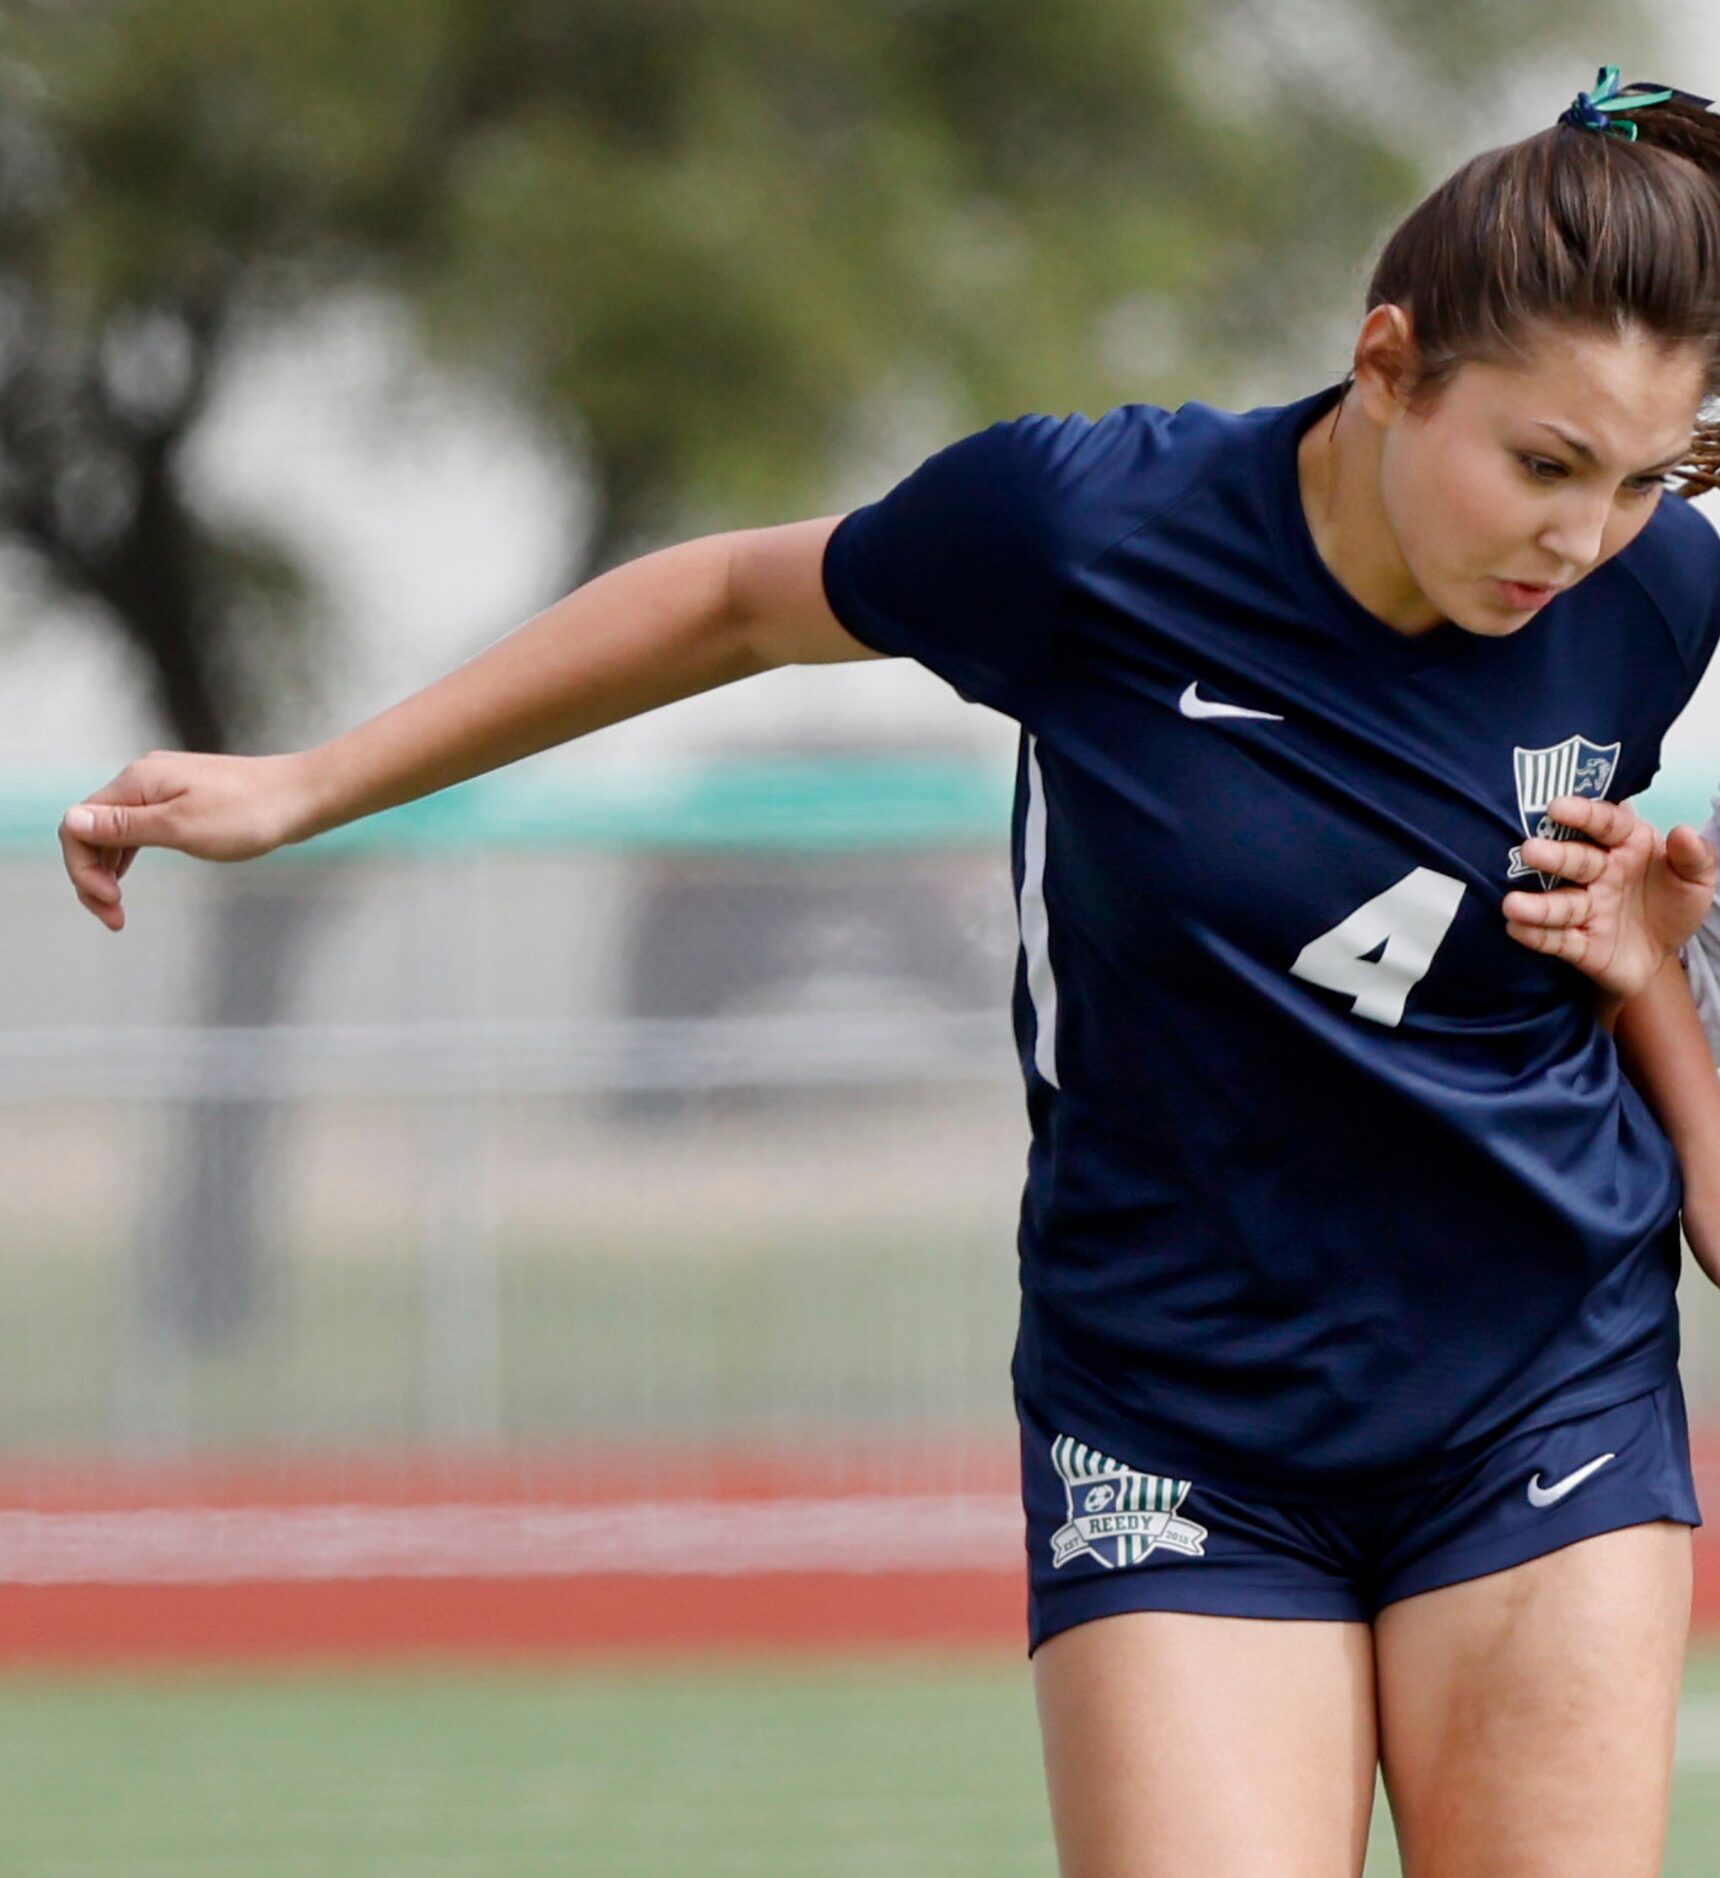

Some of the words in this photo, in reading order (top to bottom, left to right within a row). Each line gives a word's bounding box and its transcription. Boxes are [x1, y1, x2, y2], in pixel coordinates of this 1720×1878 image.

[1288, 866, 1467, 1028] 4
[1089, 1515, 1153, 1534] REEDY
[1063, 1537, 1080, 1551] EST
